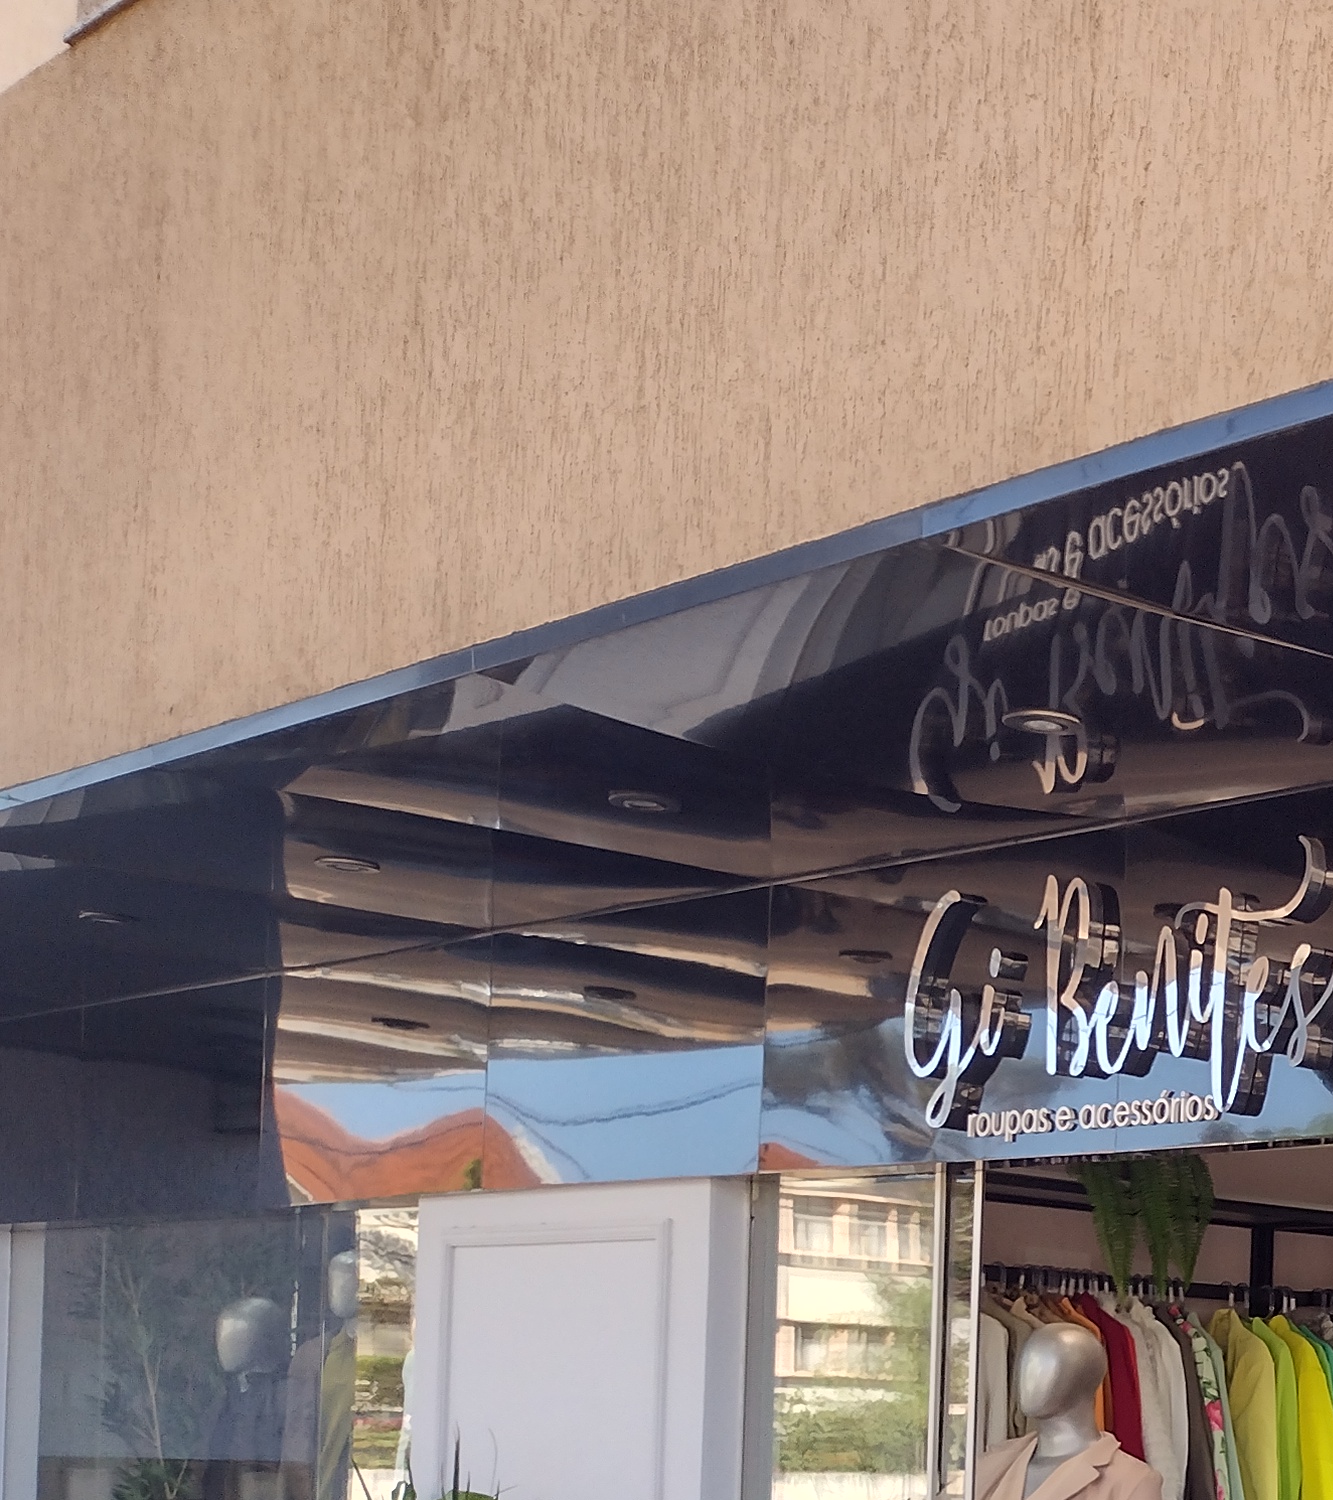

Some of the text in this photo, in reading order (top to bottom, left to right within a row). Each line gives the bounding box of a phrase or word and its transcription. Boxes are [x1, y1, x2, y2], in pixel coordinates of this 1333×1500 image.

[903, 889, 1006, 1129] Gi
[966, 1090, 1220, 1142] roupas e acessórios
